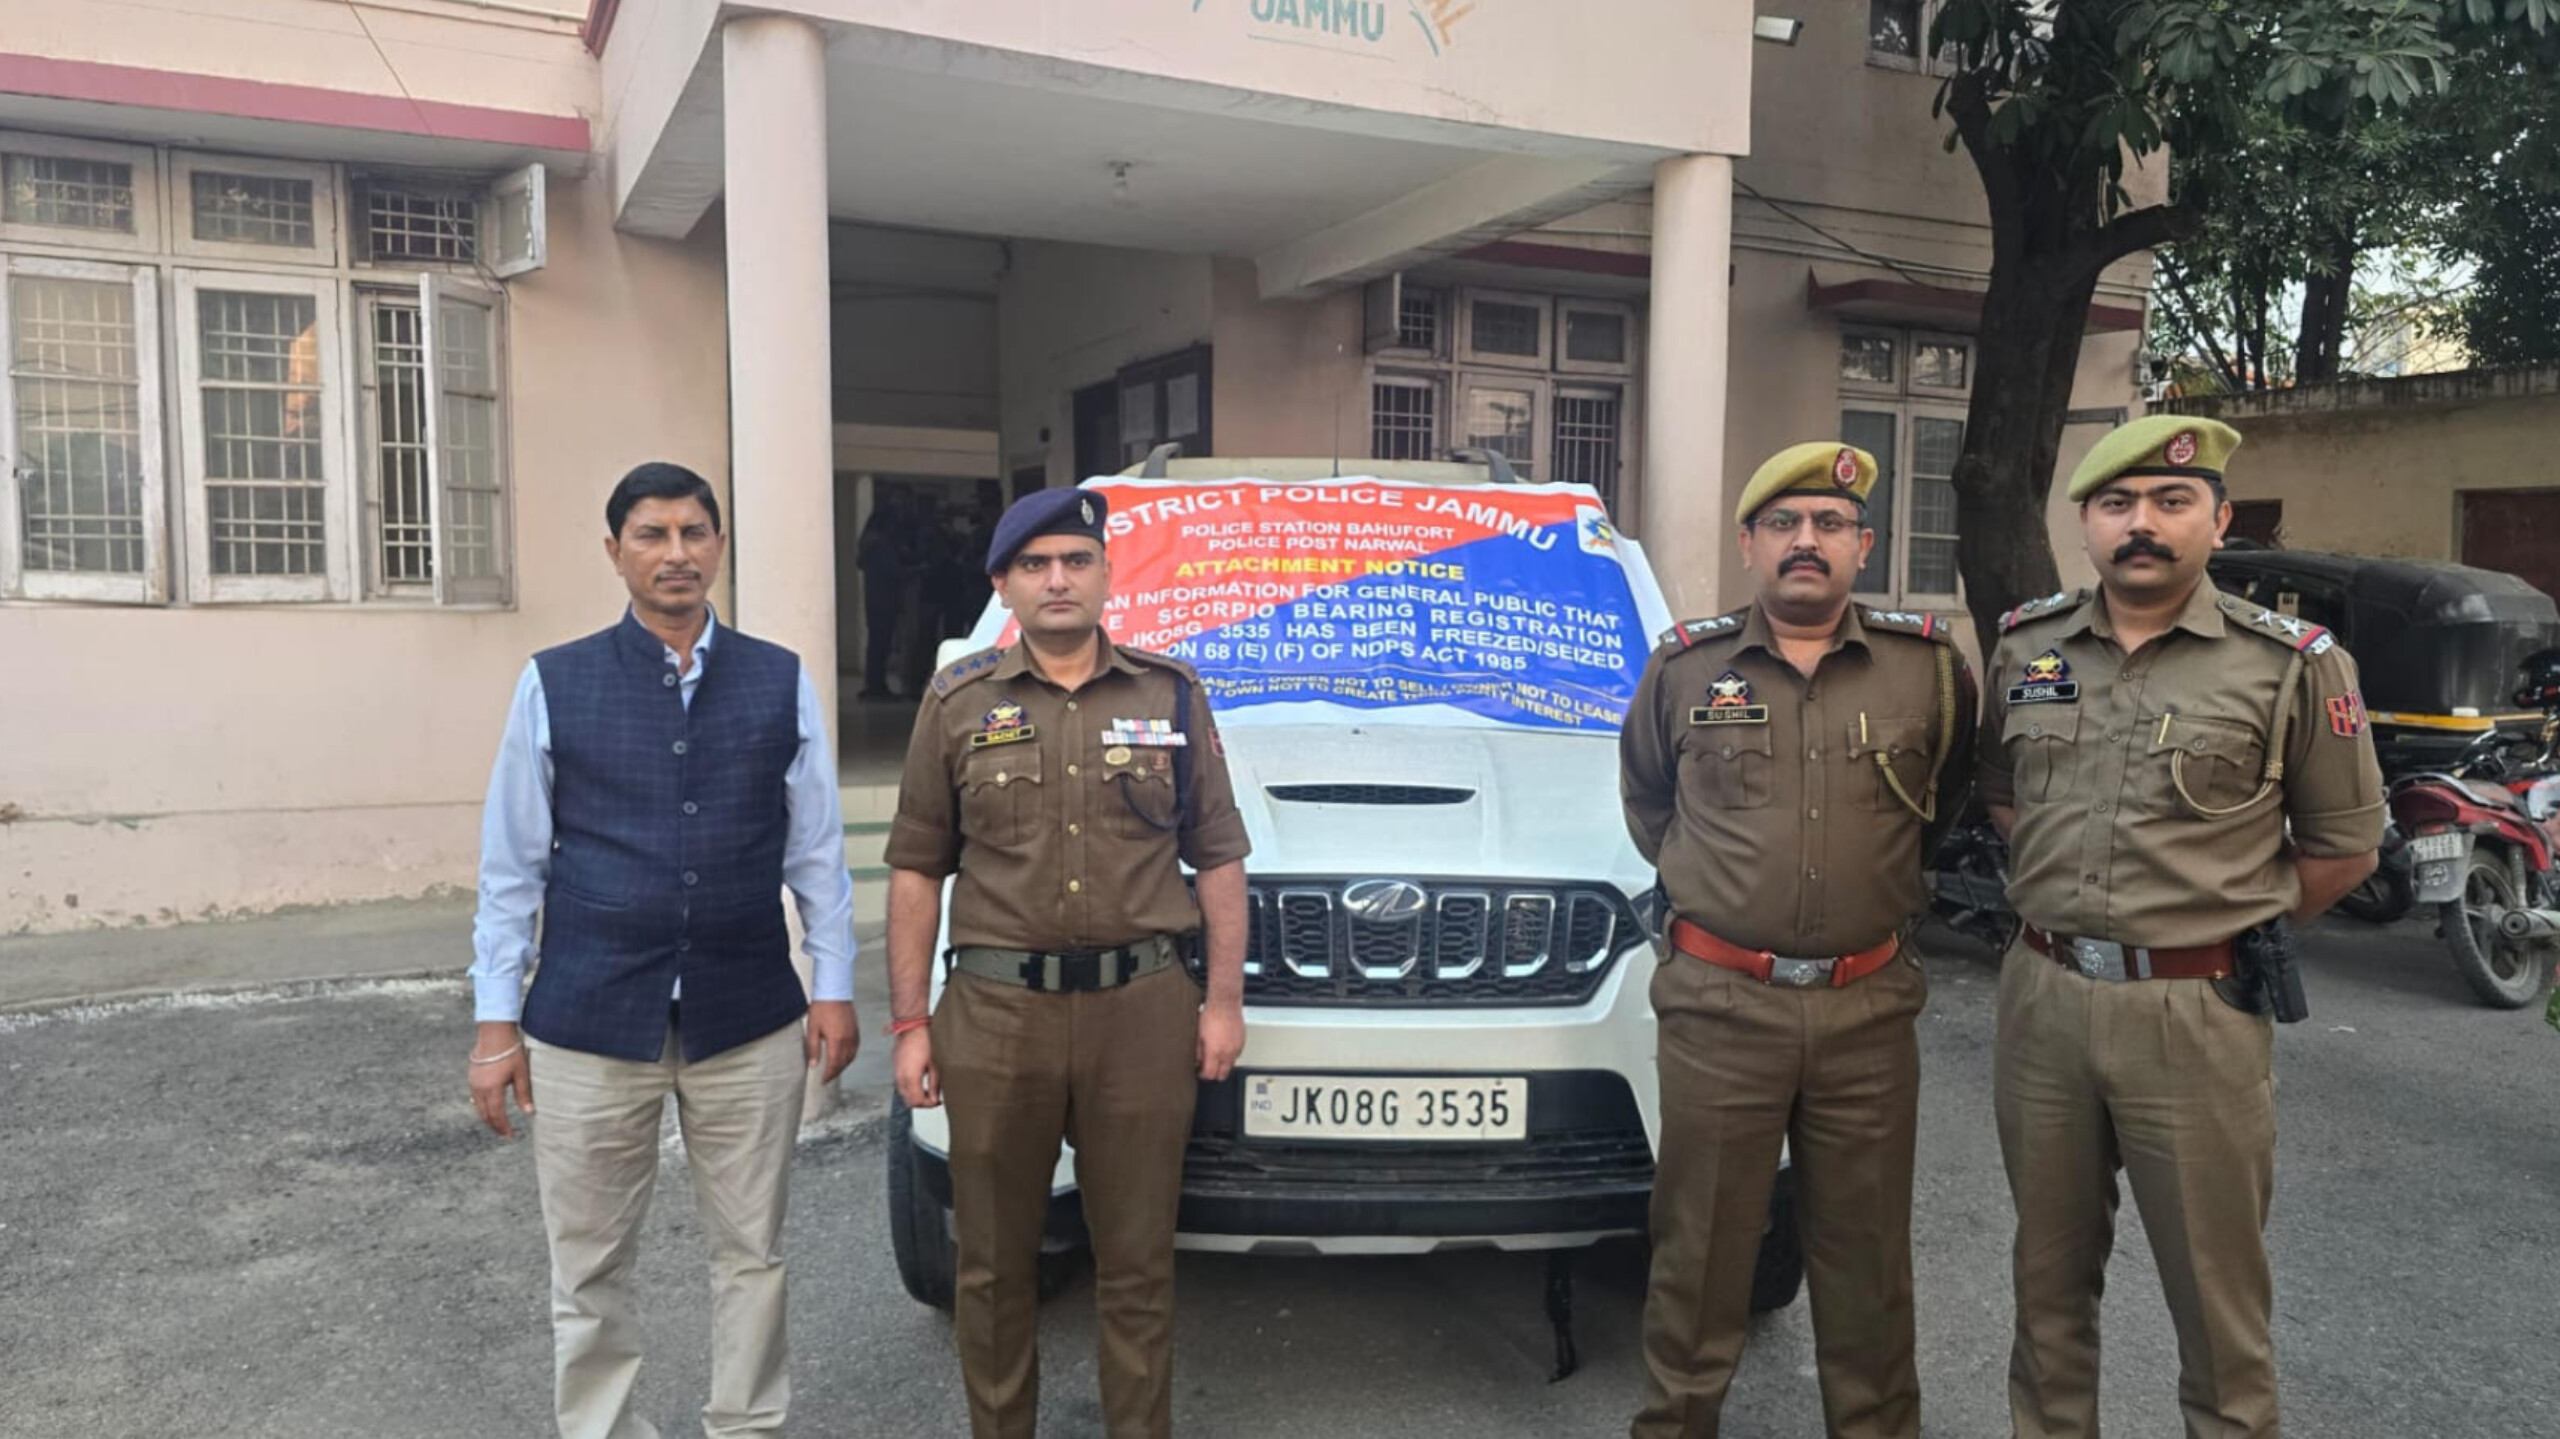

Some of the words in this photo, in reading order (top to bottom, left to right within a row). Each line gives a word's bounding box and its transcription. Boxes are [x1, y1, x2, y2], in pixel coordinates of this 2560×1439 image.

[1103, 488, 1246, 543] ISTRICT
[1259, 486, 1403, 507] POLICE
[1415, 496, 1558, 550] JAMMU
[1181, 522, 1253, 537] POLICE
[1259, 521, 1341, 535] STATION
[1347, 522, 1455, 541] BAHUFORT
[1208, 536, 1280, 551] POLICE
[1286, 536, 1337, 550] POST
[1344, 539, 1430, 555] NARWAL
[1175, 557, 1355, 577] ATTACHMENT
[1365, 559, 1465, 581] NOTICE
[1136, 582, 1295, 607] INFORMATION
[1302, 584, 1349, 599] FOR
[1357, 584, 1469, 606] GENERAL
[1474, 592, 1557, 617] PUBLIC
[1562, 605, 1620, 630] THAT
[1157, 601, 1276, 626] SCORPIO
[1294, 603, 1414, 620] BEARING
[1430, 608, 1623, 650] REGISTRATION
[1204, 642, 1230, 659] 68
[1237, 643, 1267, 663] (E)
[1275, 643, 1305, 663] (F)
[1311, 643, 1343, 659] OF
[1351, 640, 1415, 660] NDPS
[1420, 647, 1468, 664] ACT
[1474, 652, 1528, 671] 1985
[1218, 623, 1271, 639] 3535
[1286, 623, 1336, 639] HAS
[1352, 620, 1416, 639] BEEN
[1431, 629, 1625, 670] FREEZED/SEIZED
[1268, 682, 1303, 693] NOT
[1308, 682, 1329, 693] TO
[1333, 686, 1397, 702] CREATE
[1511, 692, 1584, 726] INTEREST
[1334, 677, 1368, 688] NOT
[1372, 676, 1395, 689] TO
[1515, 682, 1548, 700] NOT
[1551, 691, 1573, 708] TO
[1574, 700, 1623, 726] LEASE
[2022, 686, 2059, 699] SUSHIL
[1280, 1087, 1400, 1126] JK08G
[1416, 1089, 1509, 1127] 3535
